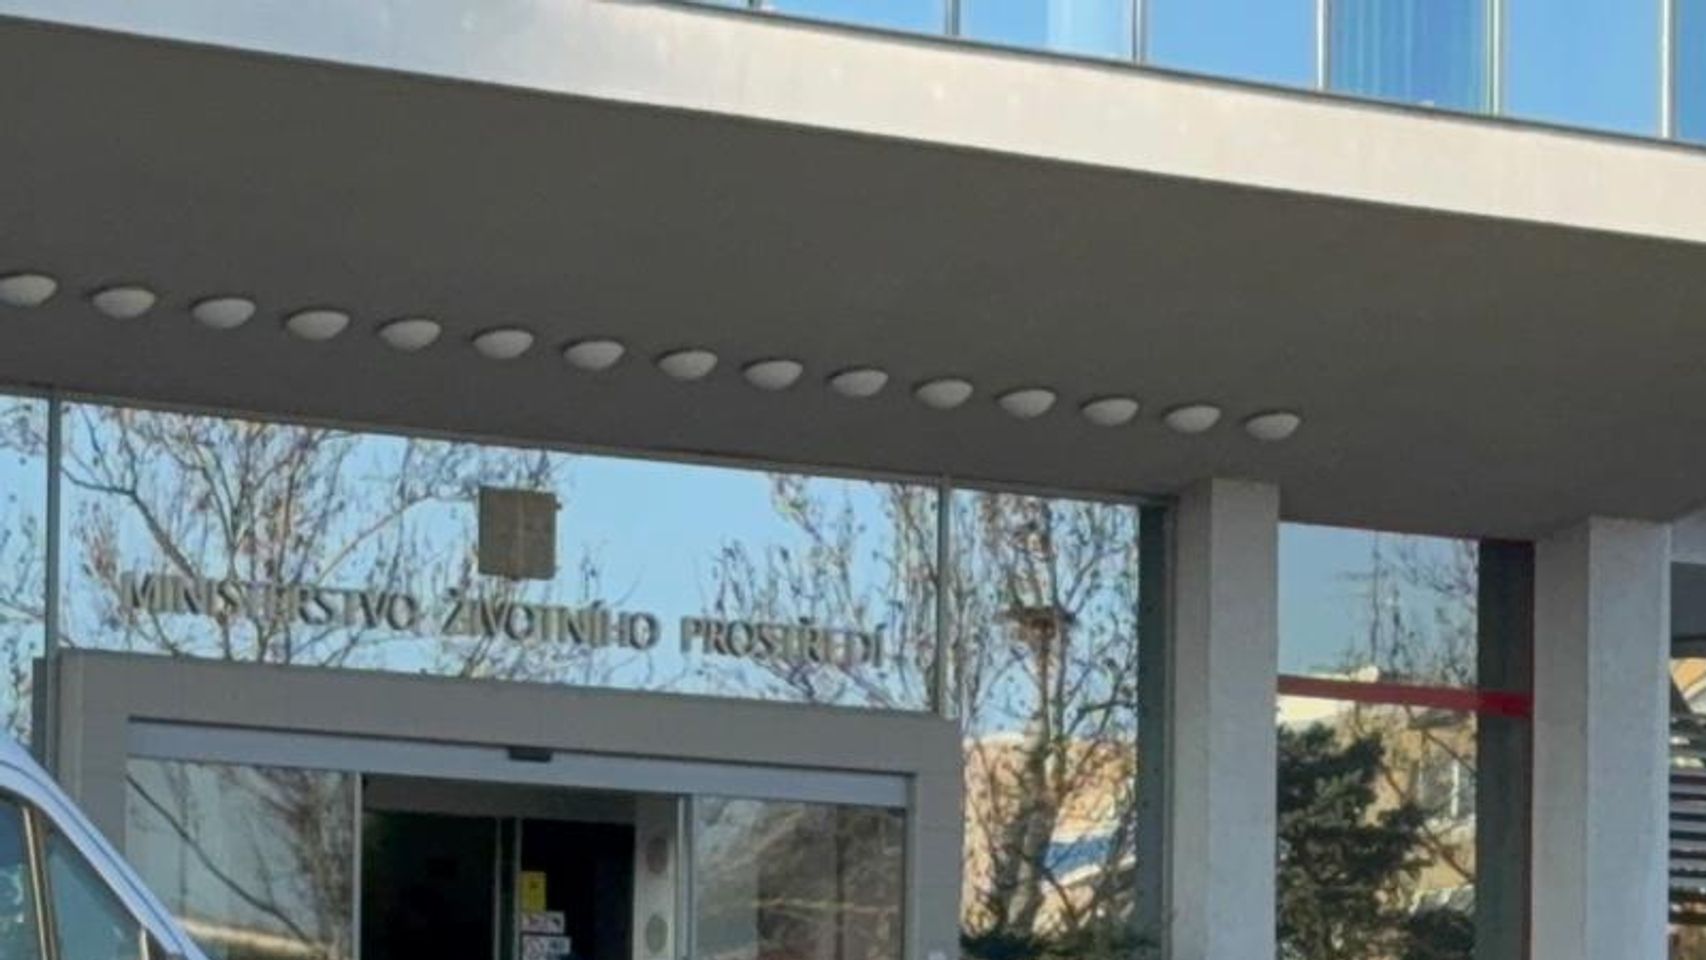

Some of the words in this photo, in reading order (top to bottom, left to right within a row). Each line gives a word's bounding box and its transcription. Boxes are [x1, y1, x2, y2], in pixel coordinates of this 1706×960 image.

[121, 572, 416, 630] MINISTERSTVO
[442, 588, 660, 650] ŽIVOTNÍHO
[680, 615, 887, 668] PROSTŘEDÍ
